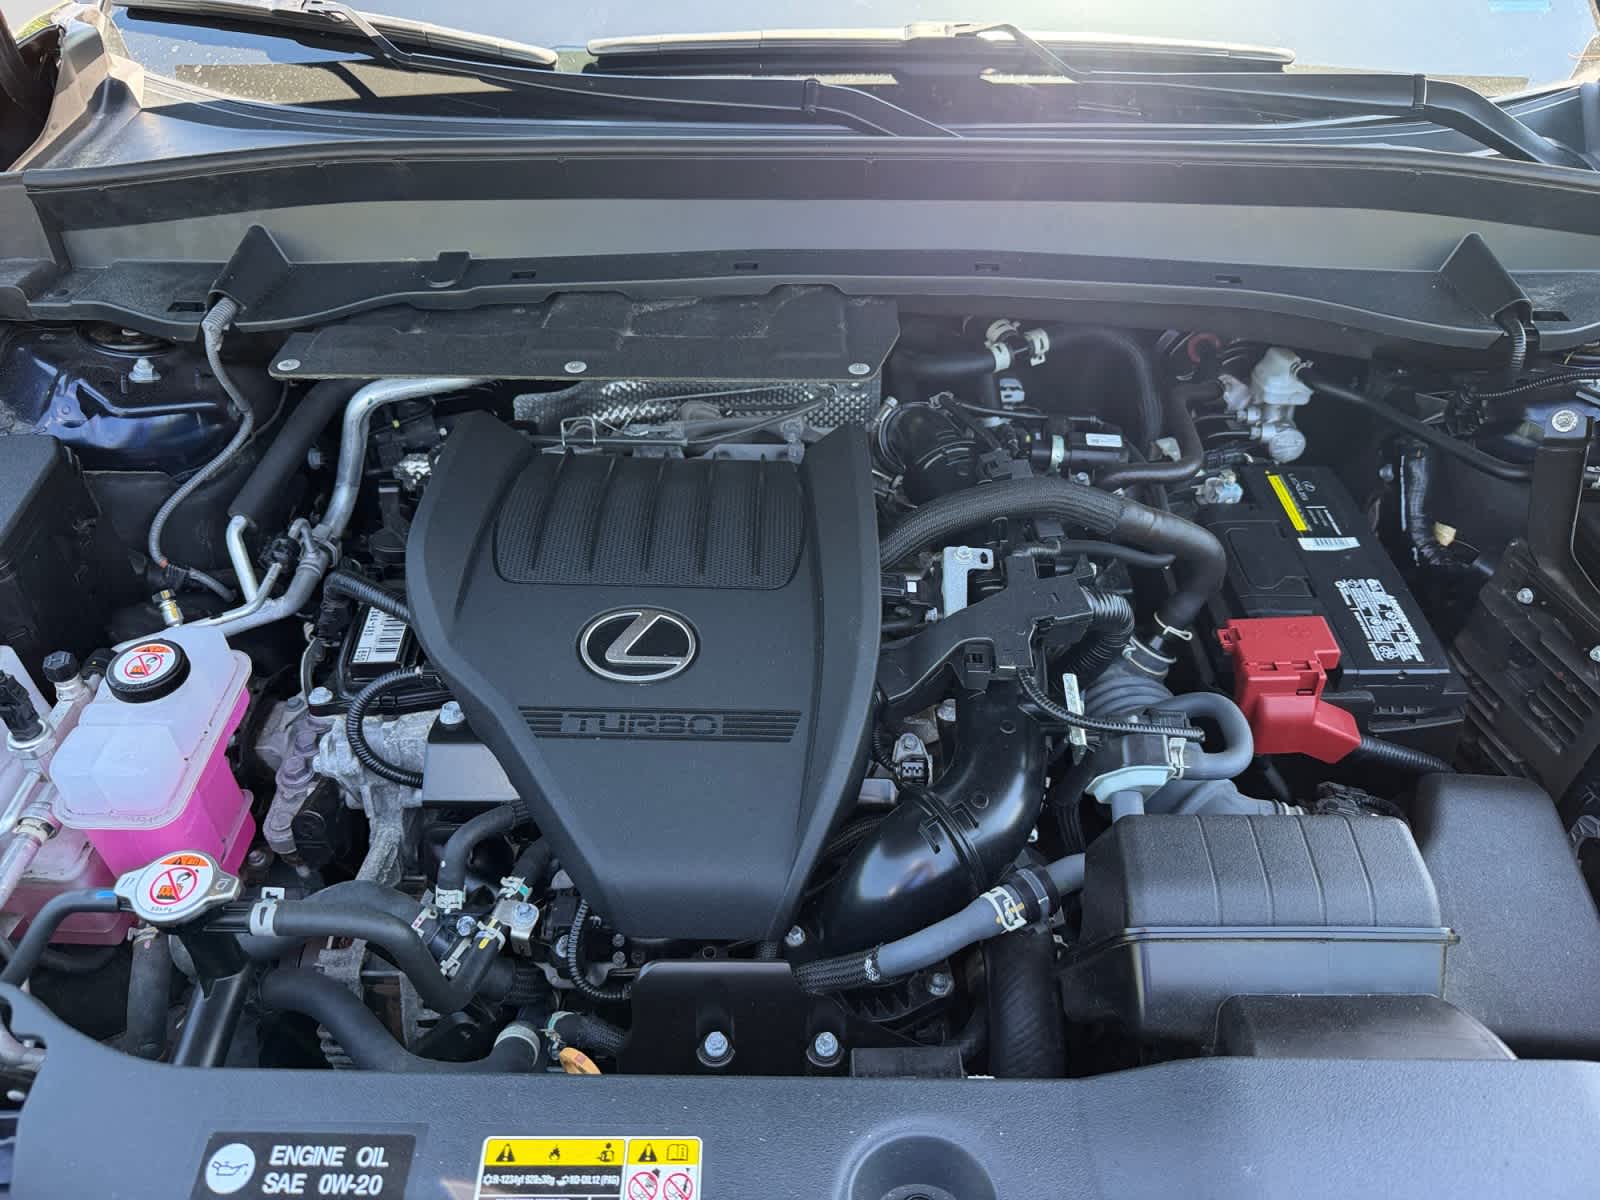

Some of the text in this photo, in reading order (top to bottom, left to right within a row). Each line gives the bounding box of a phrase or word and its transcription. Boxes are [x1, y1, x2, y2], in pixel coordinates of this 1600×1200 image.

[568, 713, 717, 735] TURBO
[269, 1145, 389, 1168] ENGINE OIL
[262, 1173, 383, 1196] SAE 0W-20
